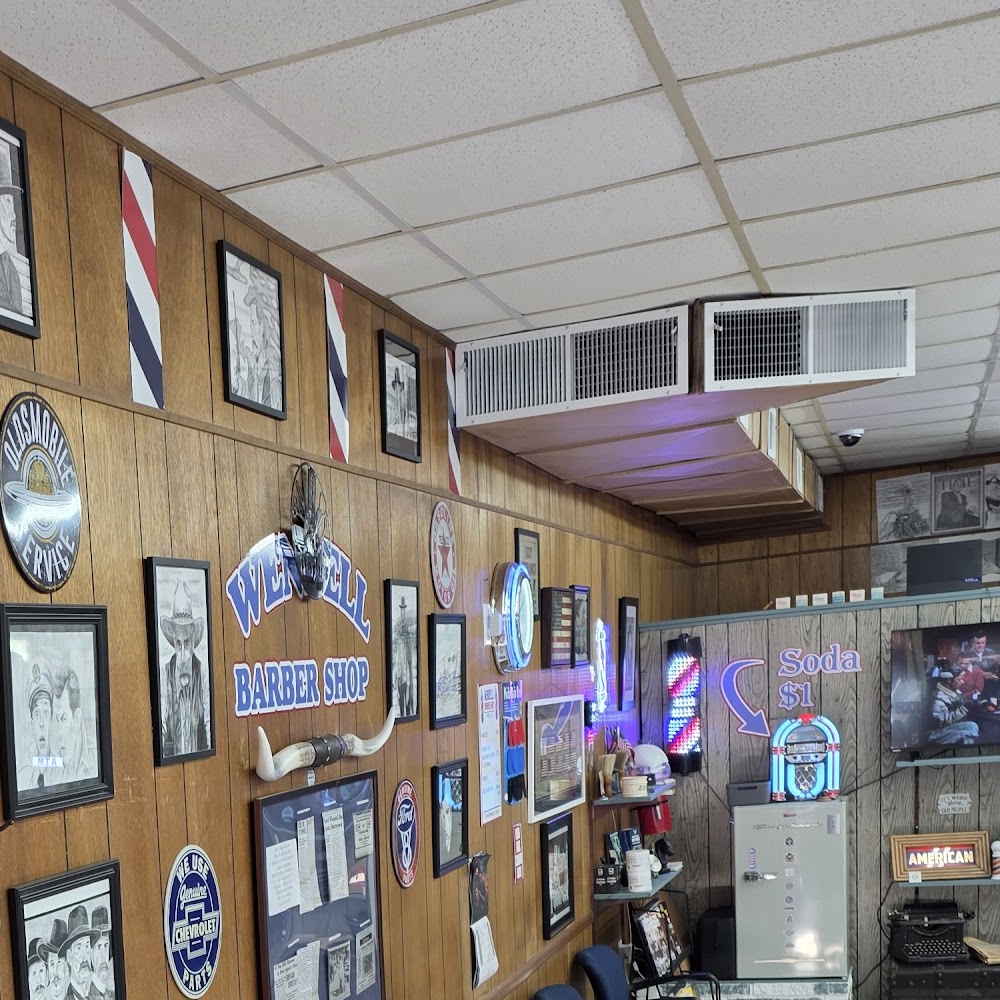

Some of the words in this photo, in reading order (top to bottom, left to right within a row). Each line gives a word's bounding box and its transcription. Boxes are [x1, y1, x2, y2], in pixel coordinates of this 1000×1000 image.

[3, 401, 75, 488] OLDSMOBILE
[9, 522, 76, 583] ERVICE
[226, 532, 371, 644] WENELL
[778, 643, 862, 677] Soda
[234, 659, 320, 717] BARBER
[323, 656, 370, 706] SHOP
[778, 681, 815, 710] $1
[397, 803, 414, 827] Ford
[176, 858, 190, 883] WE
[192, 854, 210, 881] USE
[908, 850, 975, 867] AMERICAN
[179, 883, 208, 910] Genuine
[175, 918, 217, 944] CHEVROLET
[182, 960, 213, 991] PARTS
